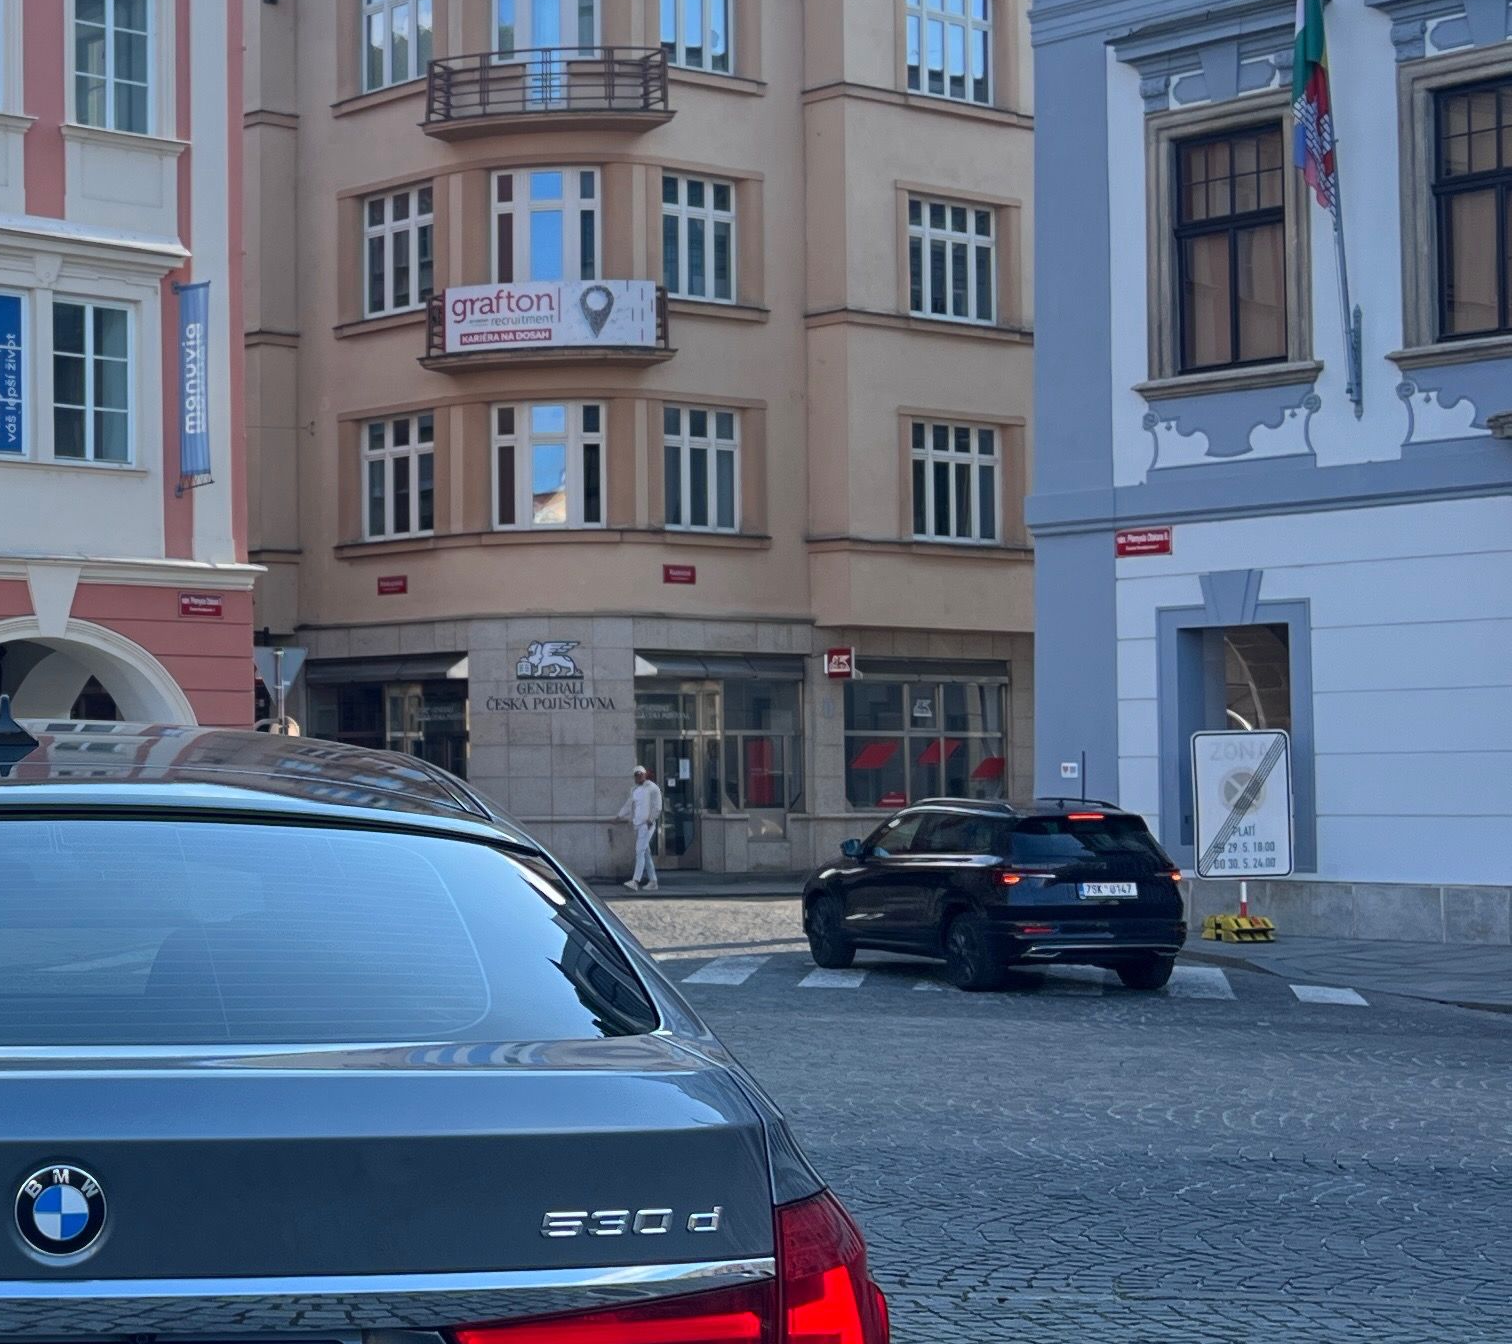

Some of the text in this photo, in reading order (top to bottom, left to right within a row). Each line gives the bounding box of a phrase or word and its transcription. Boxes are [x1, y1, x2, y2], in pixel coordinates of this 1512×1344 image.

[452, 288, 555, 323] grafton
[490, 313, 554, 327] recruitment
[501, 331, 515, 342] NA
[515, 329, 550, 341] DOSAH
[182, 323, 197, 434] manuvia
[5, 412, 17, 443] váš
[485, 696, 529, 711] ČESKÁ
[516, 682, 585, 695] GENERALI
[24, 1168, 99, 1199] BMW
[540, 1206, 724, 1239] 530 d
